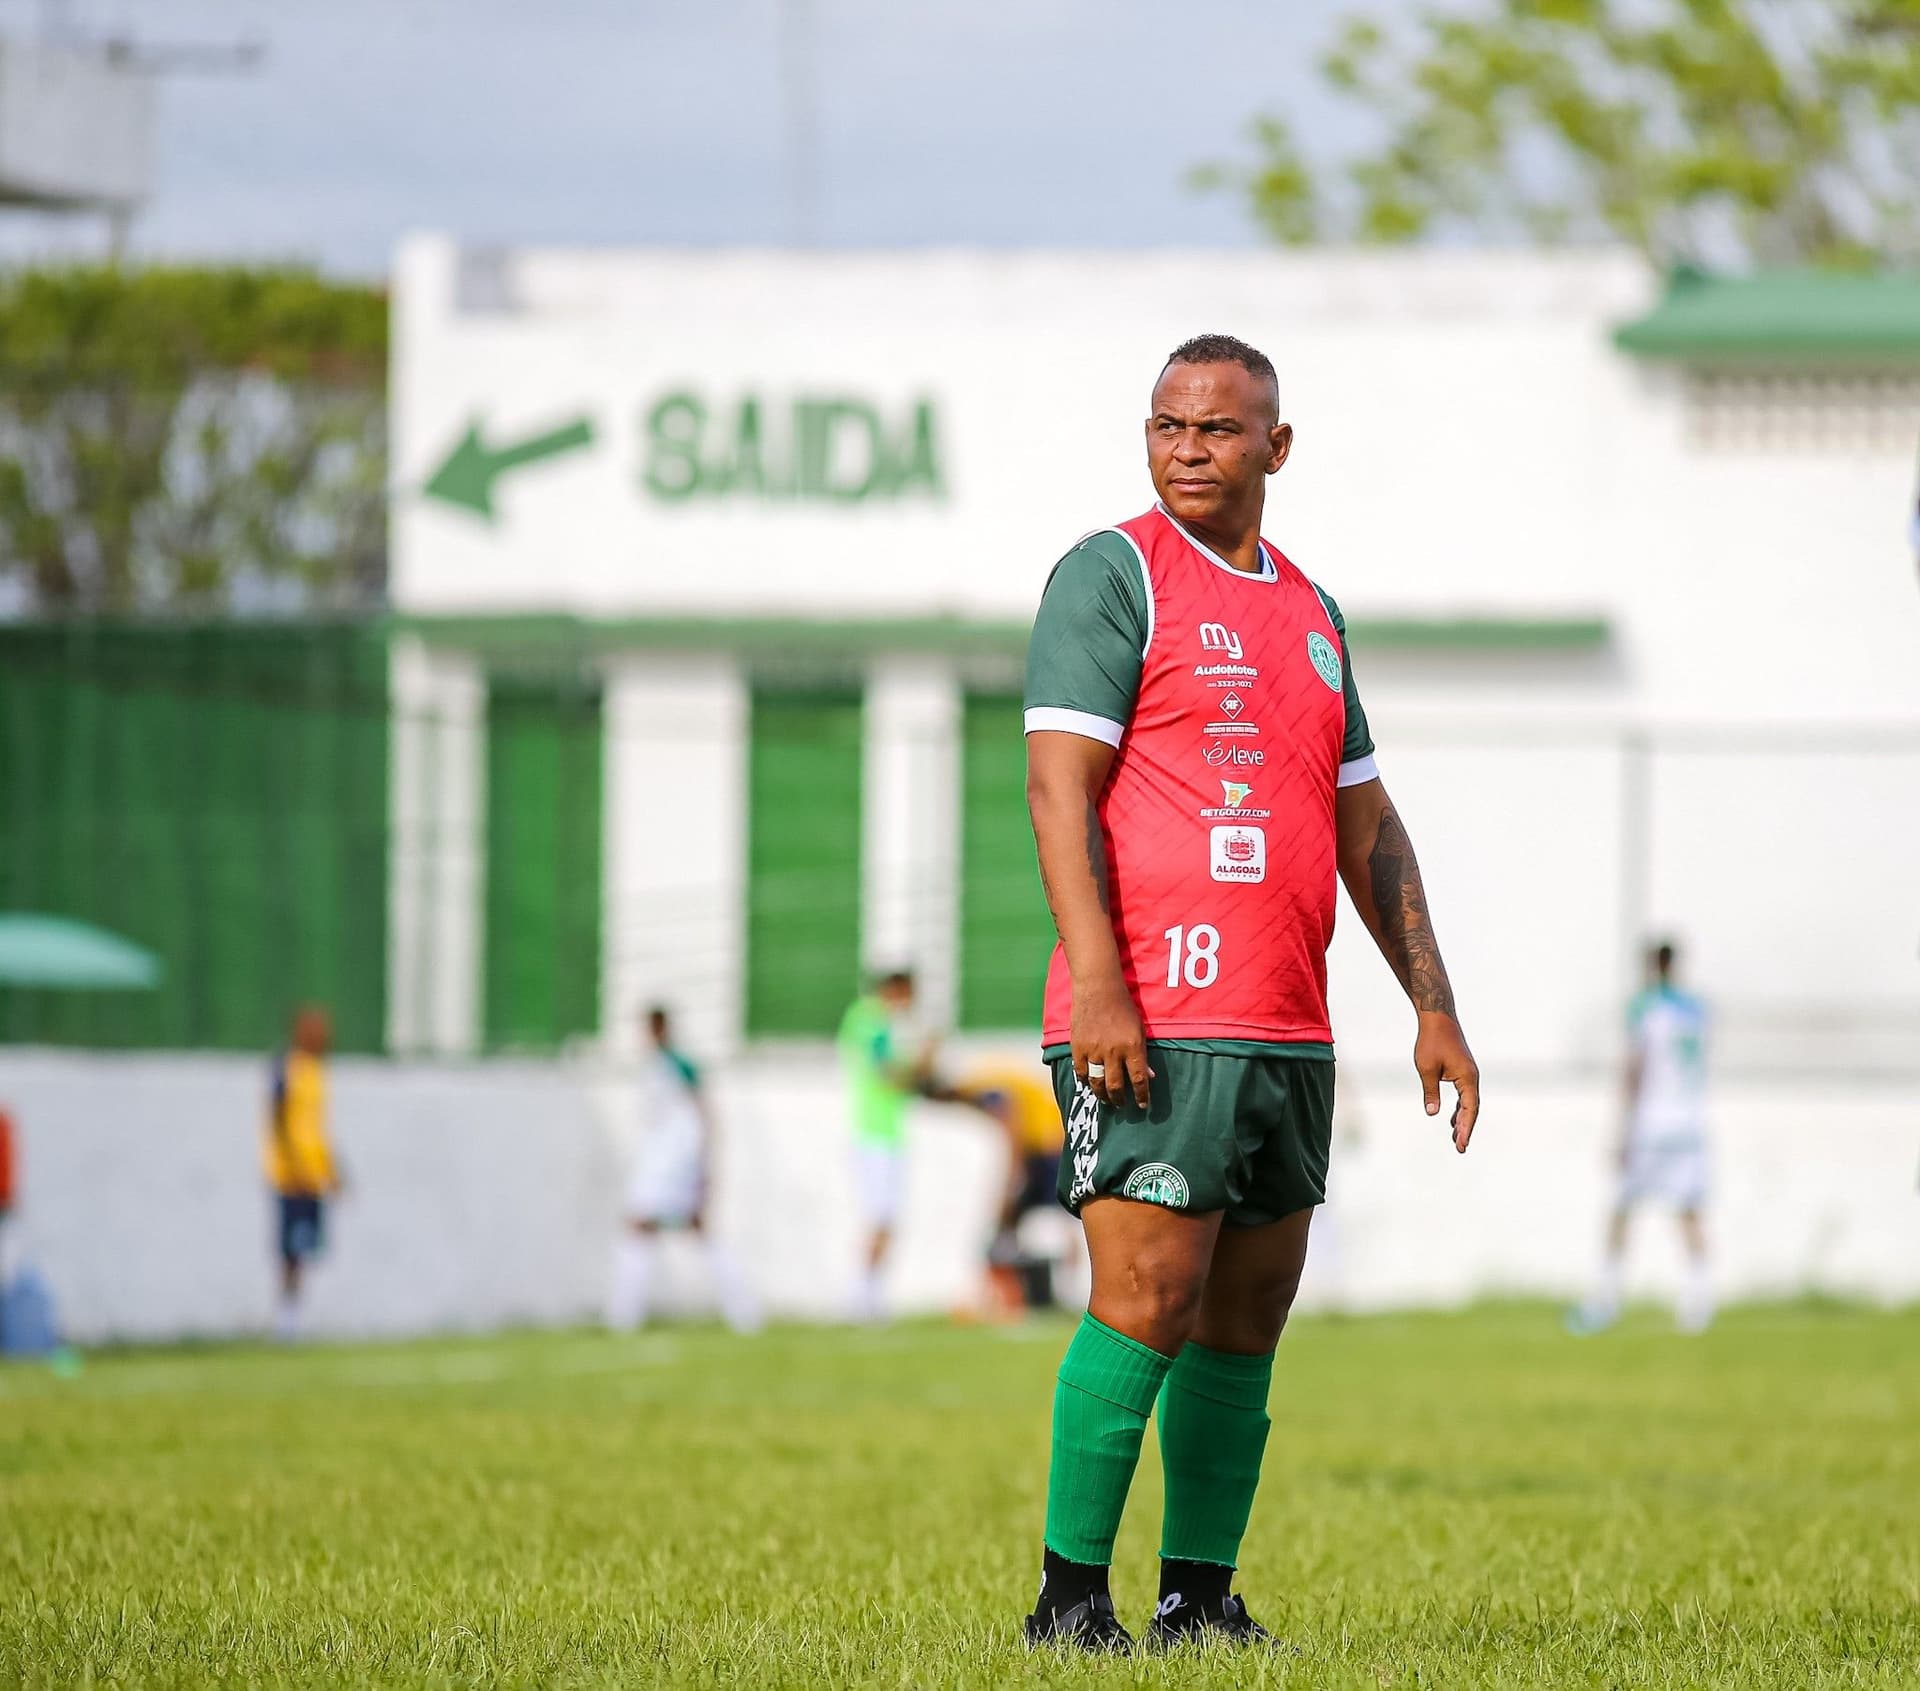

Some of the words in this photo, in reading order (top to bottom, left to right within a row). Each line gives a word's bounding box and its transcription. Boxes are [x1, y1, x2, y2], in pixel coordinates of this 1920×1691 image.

[1193, 664, 1258, 677] AudoMotos
[1200, 807, 1271, 819] BETGOL777.COM
[1216, 865, 1261, 875] ALAGOAS
[1164, 923, 1221, 989] 18
[1132, 1169, 1164, 1187] ESPORTE
[1163, 1171, 1183, 1192] CLUBE
